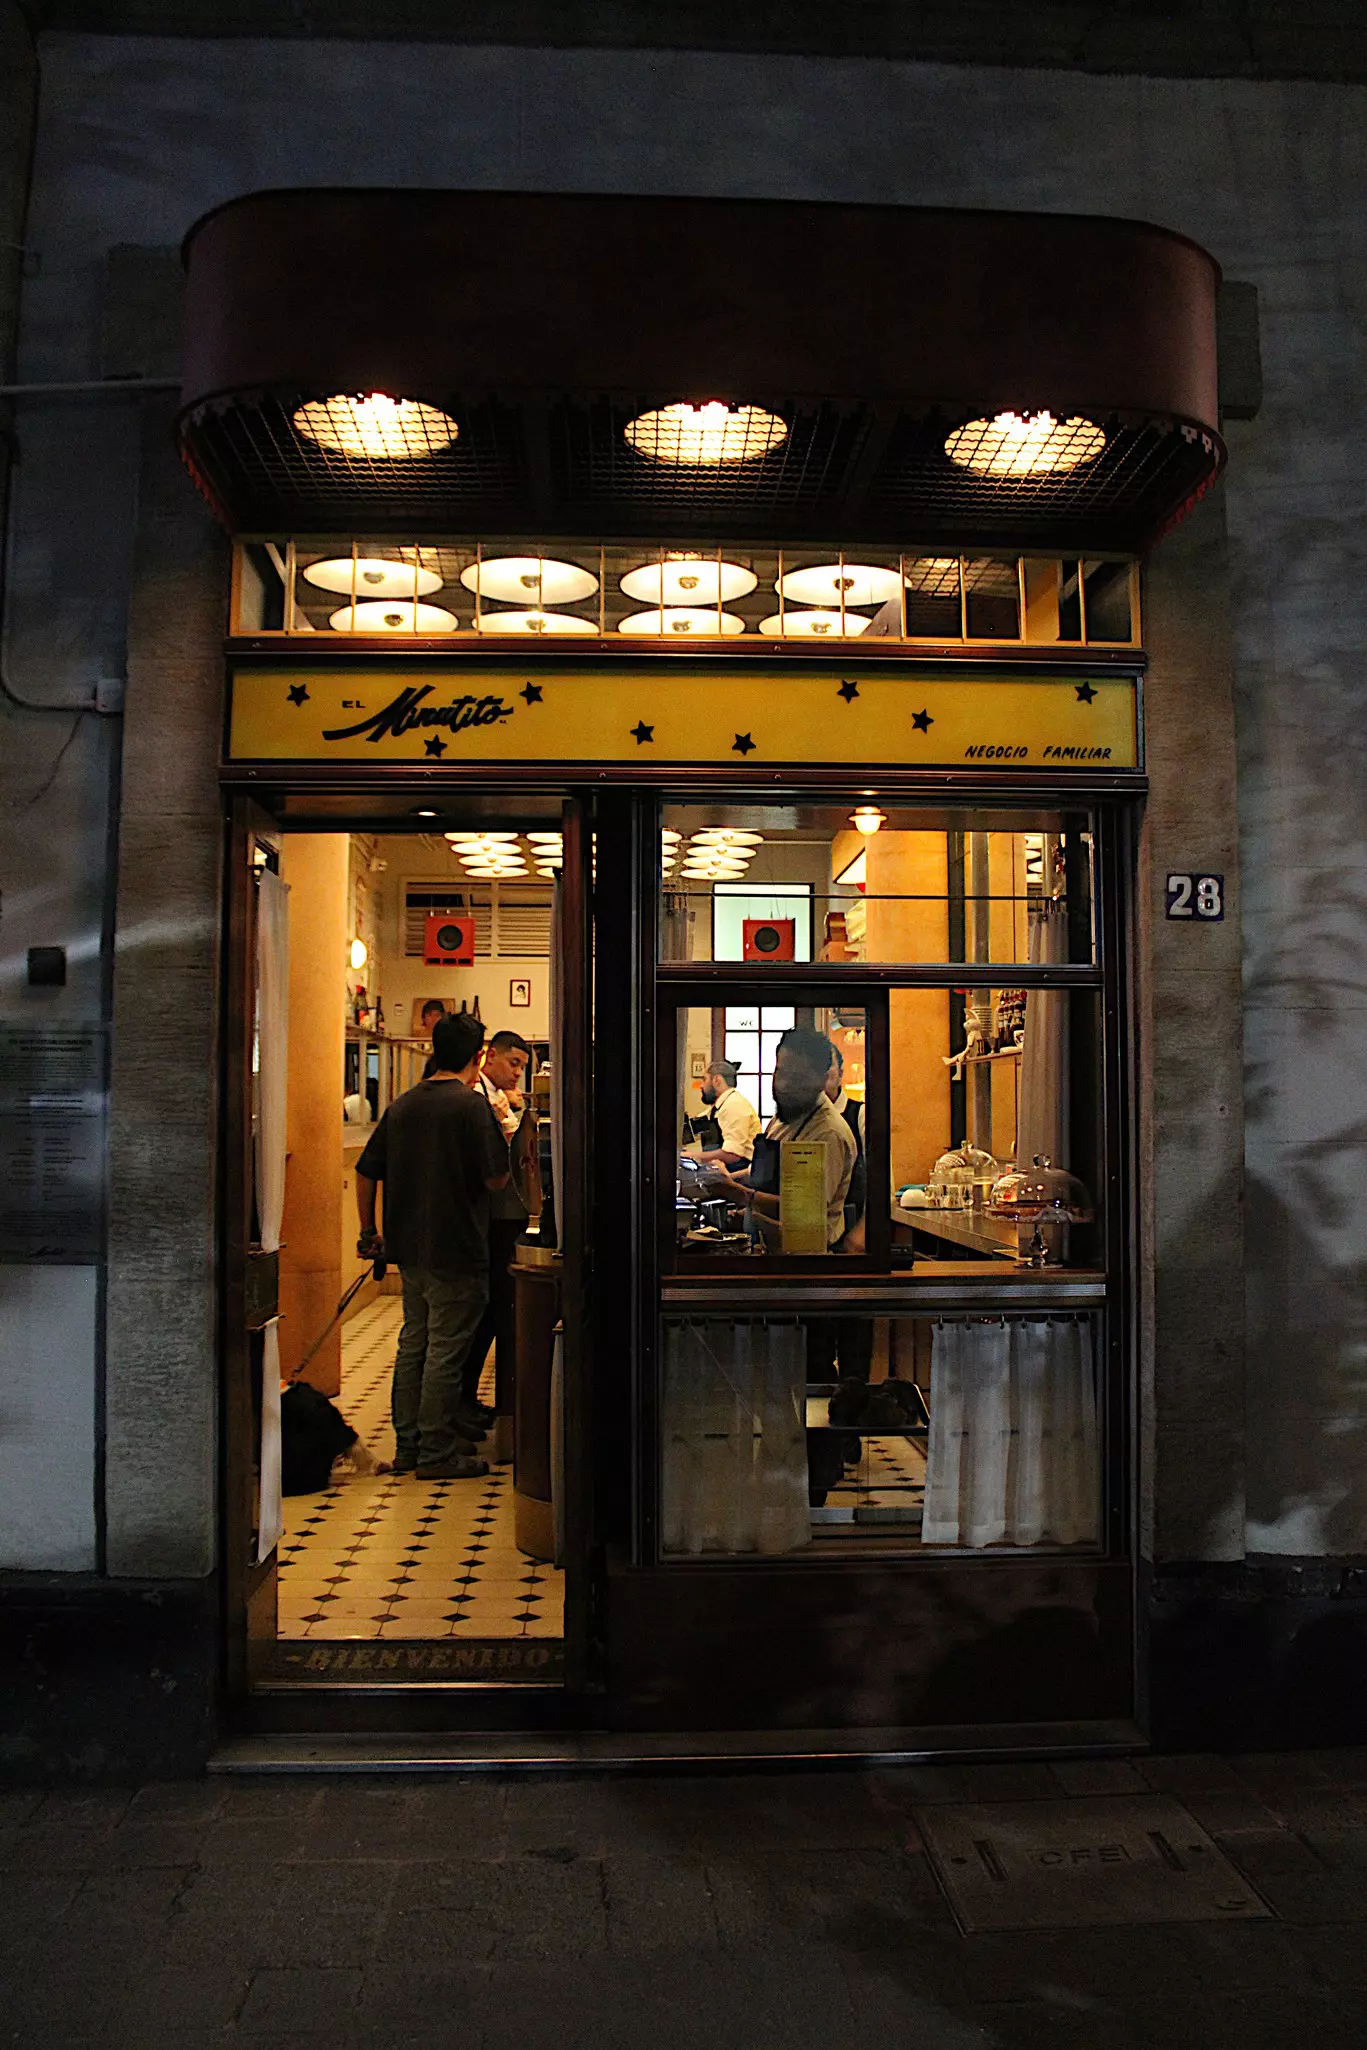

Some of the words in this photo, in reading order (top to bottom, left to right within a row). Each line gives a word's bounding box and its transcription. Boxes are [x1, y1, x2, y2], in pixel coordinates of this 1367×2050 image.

[322, 685, 513, 742] Minutito
[341, 700, 366, 709] EL
[965, 745, 1028, 759] NEGOCIO
[1043, 746, 1112, 760] FAMILIAR
[1168, 876, 1221, 917] 28
